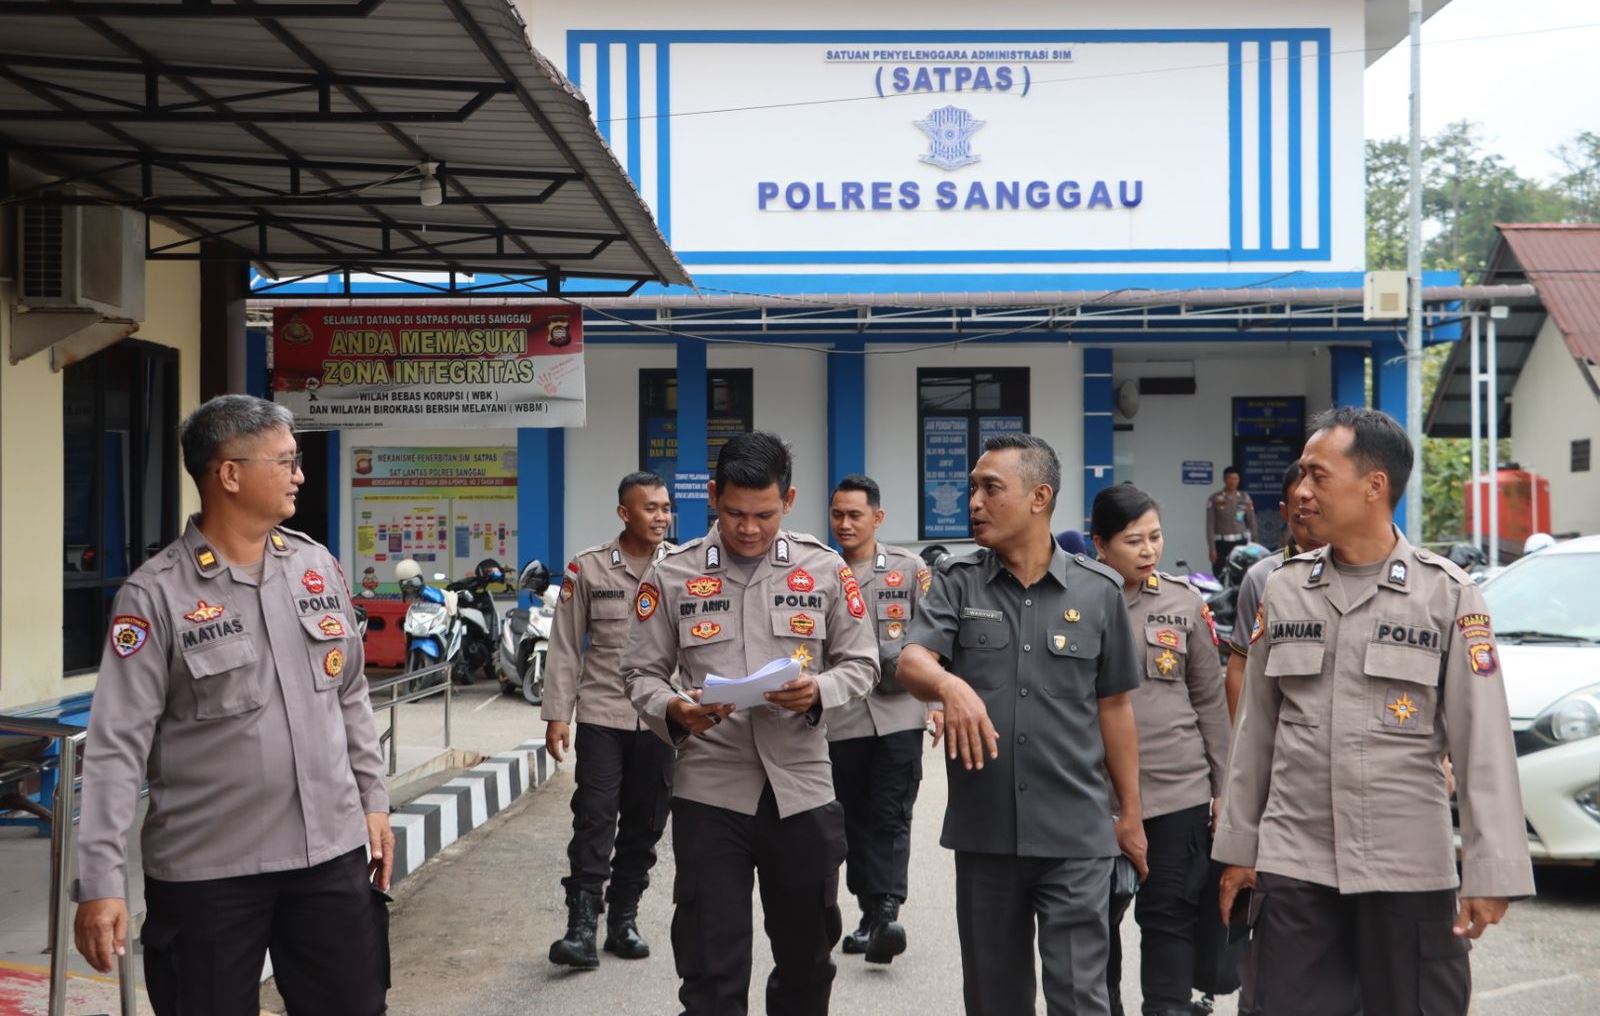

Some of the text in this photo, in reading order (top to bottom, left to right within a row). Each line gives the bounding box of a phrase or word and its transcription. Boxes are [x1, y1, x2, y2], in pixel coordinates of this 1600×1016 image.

[826, 49, 1072, 60] SATUAN PENYELENGGARA ADMINISTRASI SIM
[758, 180, 1144, 211] POLRES SANGGAU
[323, 314, 532, 325] SELAMAT DATANG DI SATPAS POLRES SANGGAU
[330, 329, 527, 355] ANDA MEMASUKI
[322, 360, 390, 385] ZONA
[394, 359, 535, 385] INTEGRITAS
[360, 392, 388, 401] WILAH
[391, 392, 422, 401] BEBAS
[423, 391, 464, 401] KORUPSI
[309, 405, 328, 415] DAN
[330, 405, 371, 414] WILAYAH
[373, 404, 423, 414] BIROKRASI
[426, 404, 459, 413] BERSIH
[461, 403, 507, 413] MELAYANI
[473, 453, 497, 462] SATPAS
[775, 594, 822, 609] POLRI
[878, 590, 908, 600] POLRI
[299, 595, 341, 614] POLRI
[1147, 614, 1188, 627] POLRI
[182, 618, 244, 649] MATIAS
[1271, 623, 1322, 640] JANUAR
[1378, 624, 1438, 649] POLRI
